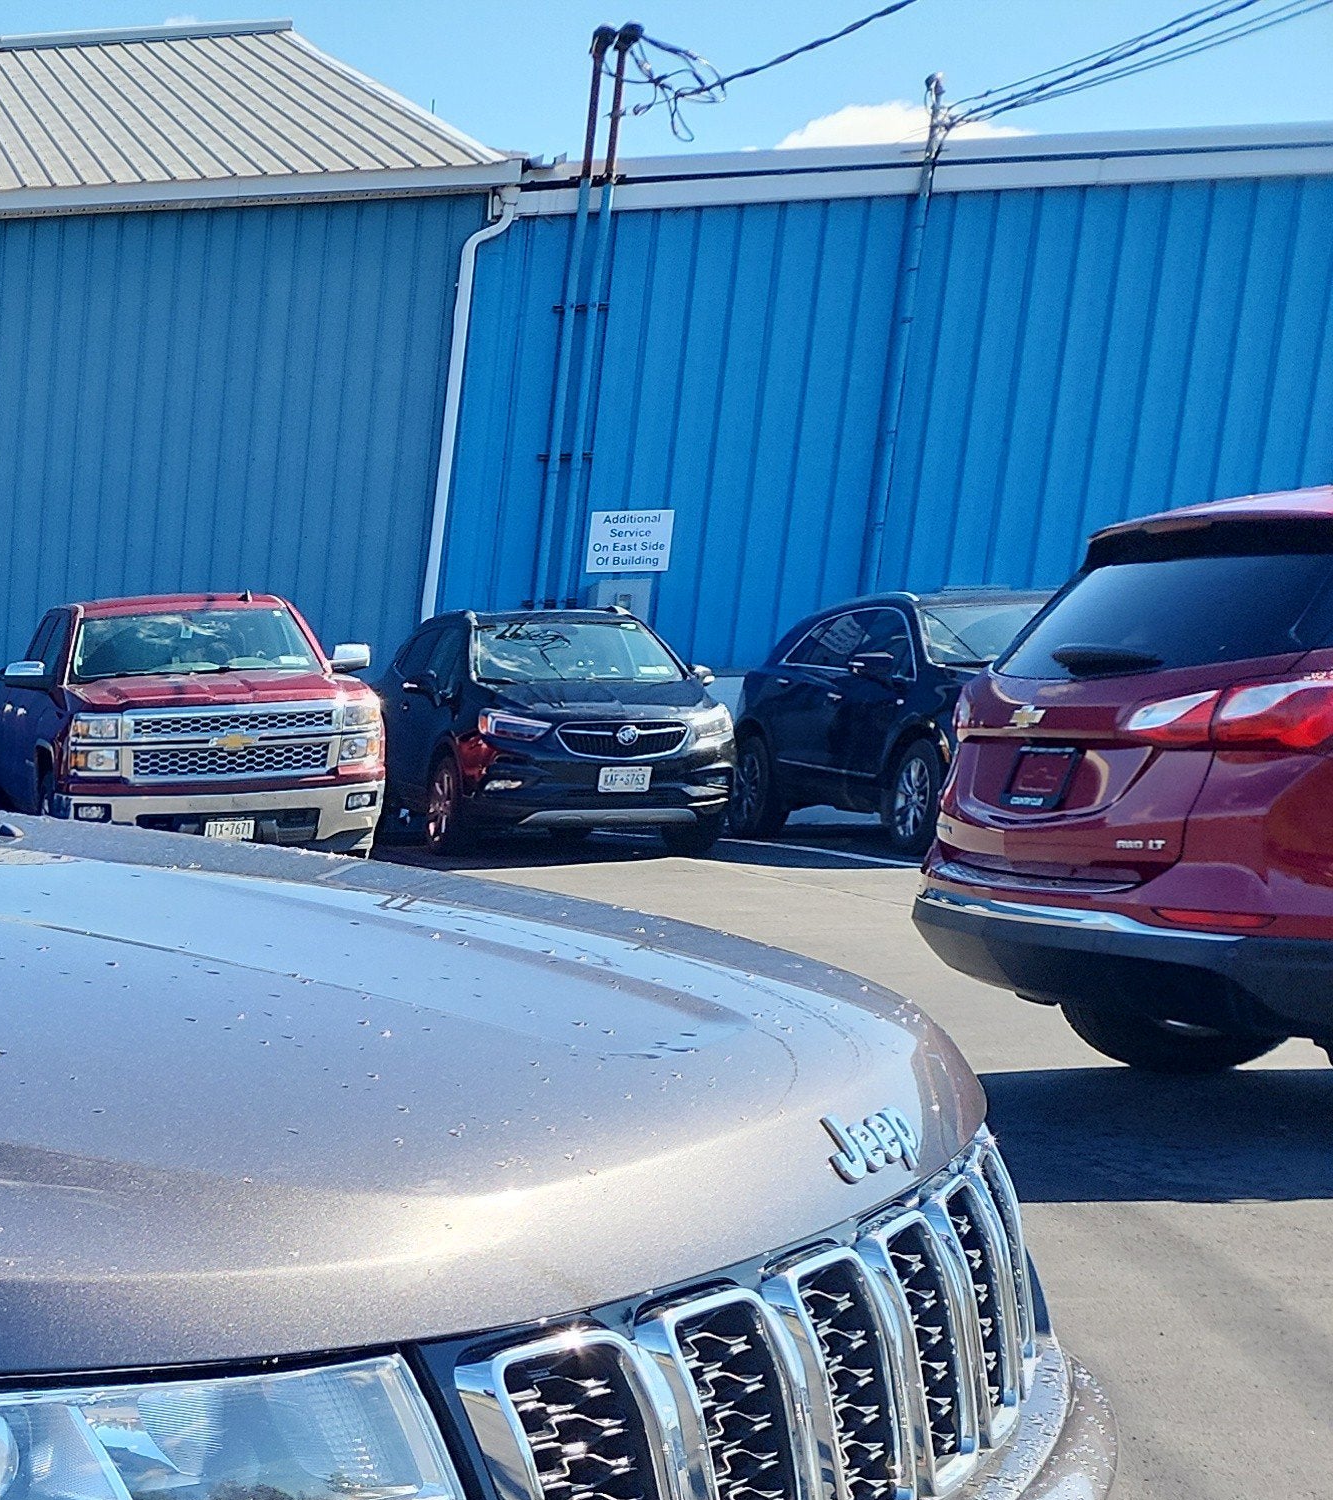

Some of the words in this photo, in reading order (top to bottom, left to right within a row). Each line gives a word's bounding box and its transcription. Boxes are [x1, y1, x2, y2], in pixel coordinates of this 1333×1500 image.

[603, 514, 661, 524] Additional
[609, 528, 652, 538] Service
[592, 542, 609, 552] On
[612, 542, 637, 552] East
[640, 541, 665, 551] Side
[595, 556, 610, 566] Of
[612, 555, 659, 566] Building
[1148, 839, 1167, 850] LT
[820, 1106, 919, 1184] Jeep
